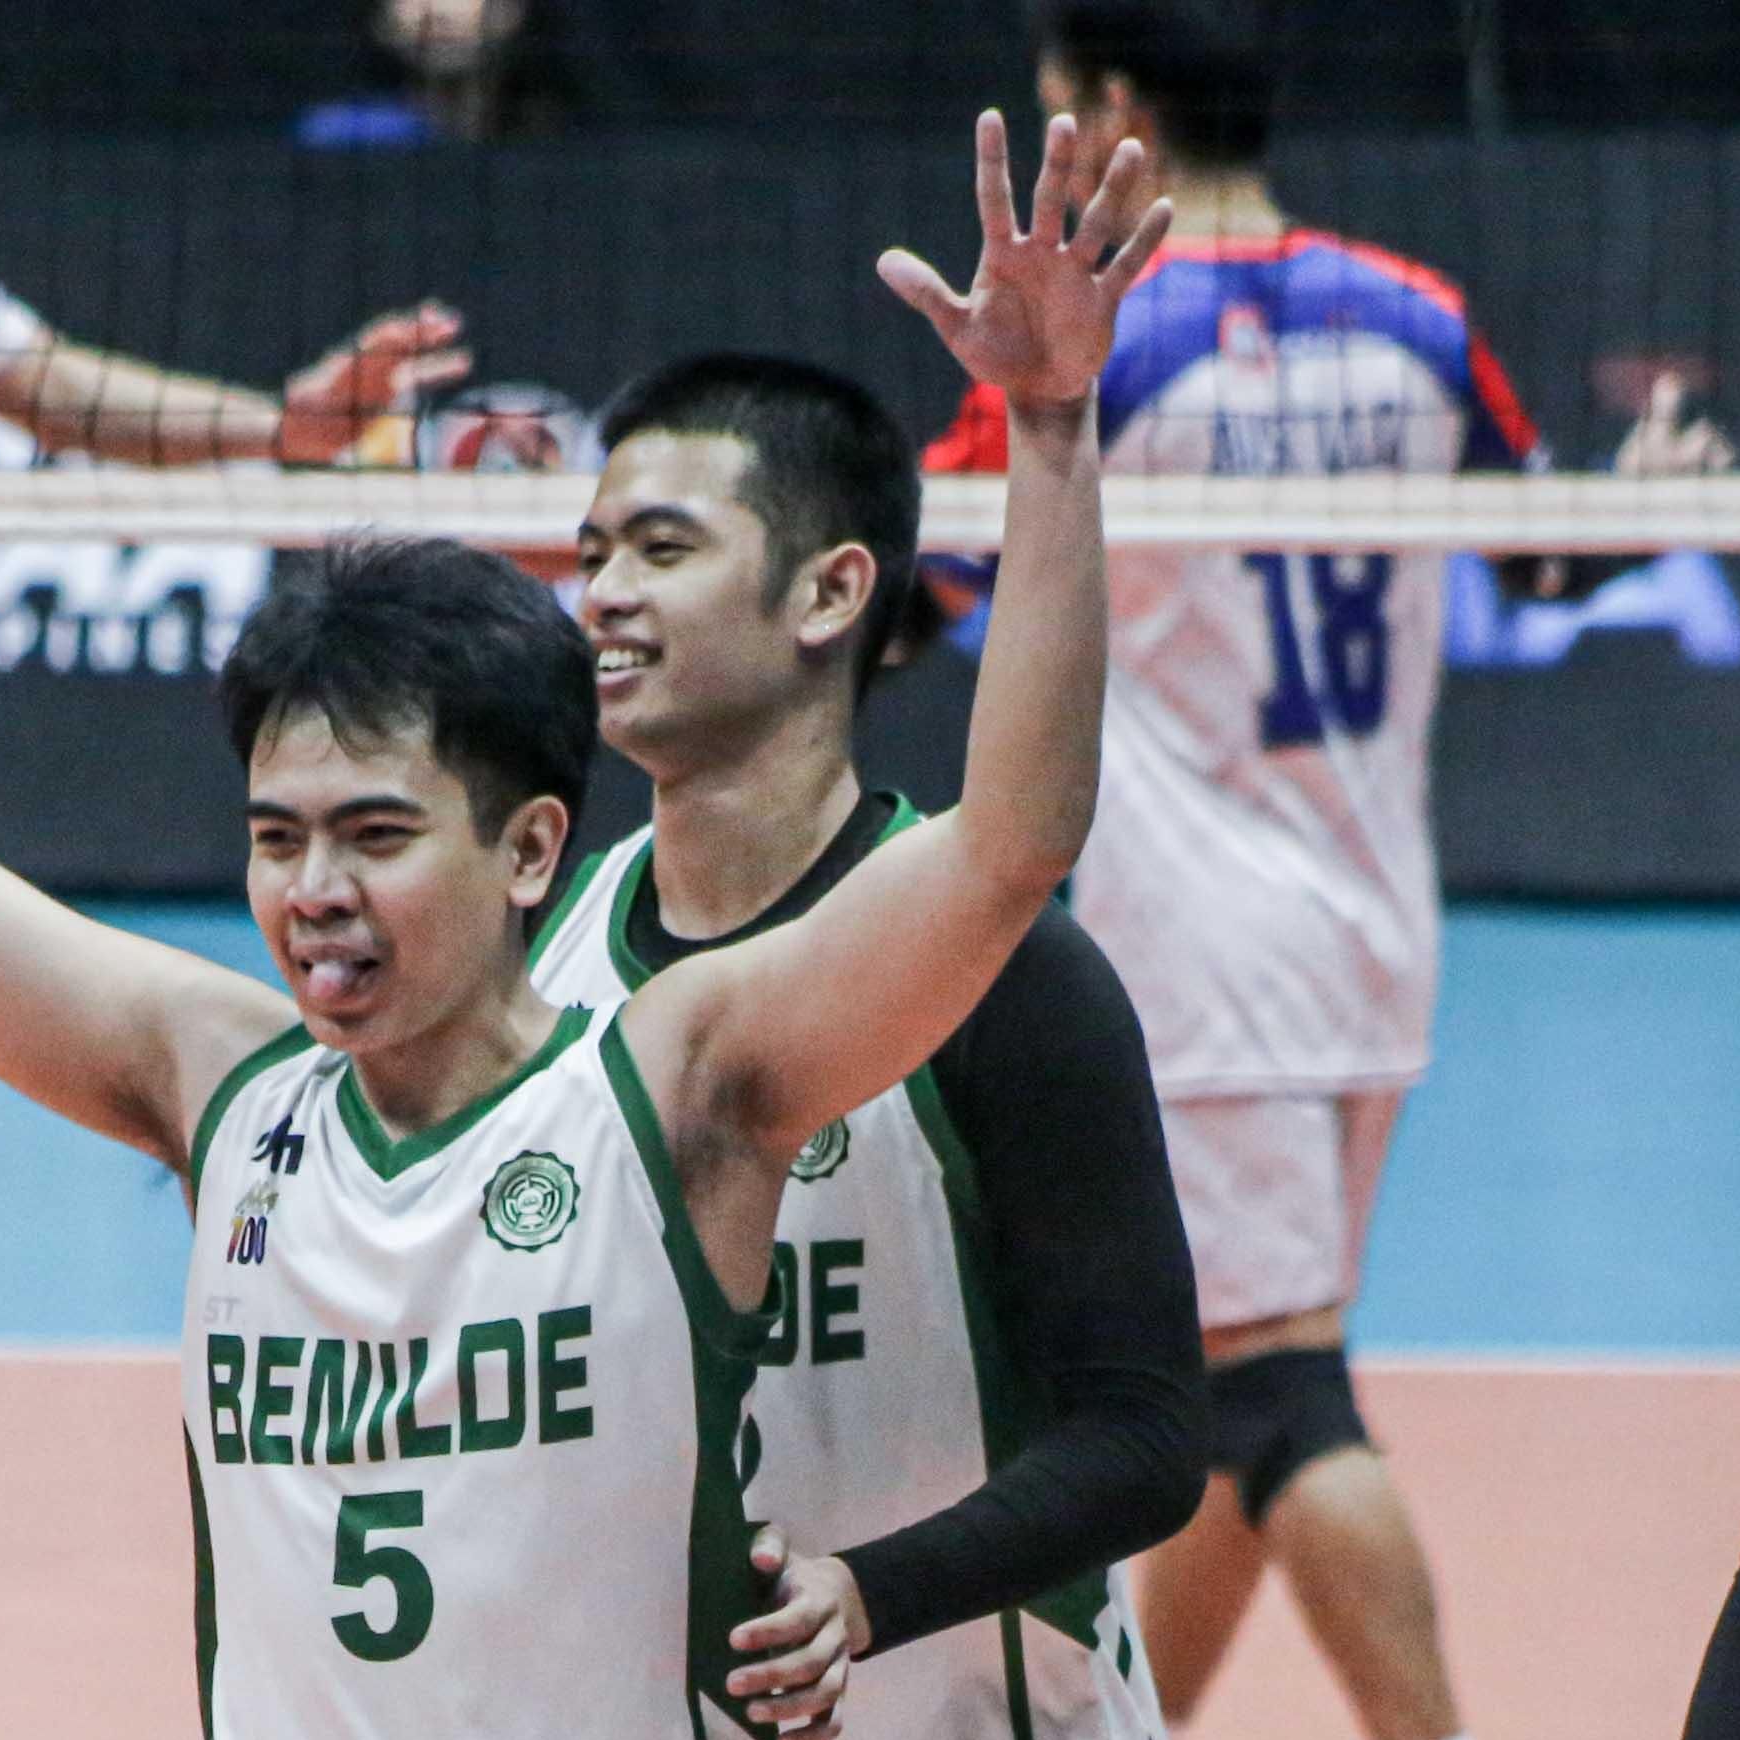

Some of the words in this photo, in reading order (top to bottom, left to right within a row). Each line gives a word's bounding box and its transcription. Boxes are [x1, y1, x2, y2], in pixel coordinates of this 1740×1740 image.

[1241, 551, 1394, 748] 18
[226, 1216, 267, 1265] 100
[207, 1305, 594, 1466] BENILDE
[330, 1489, 435, 1662] 5
